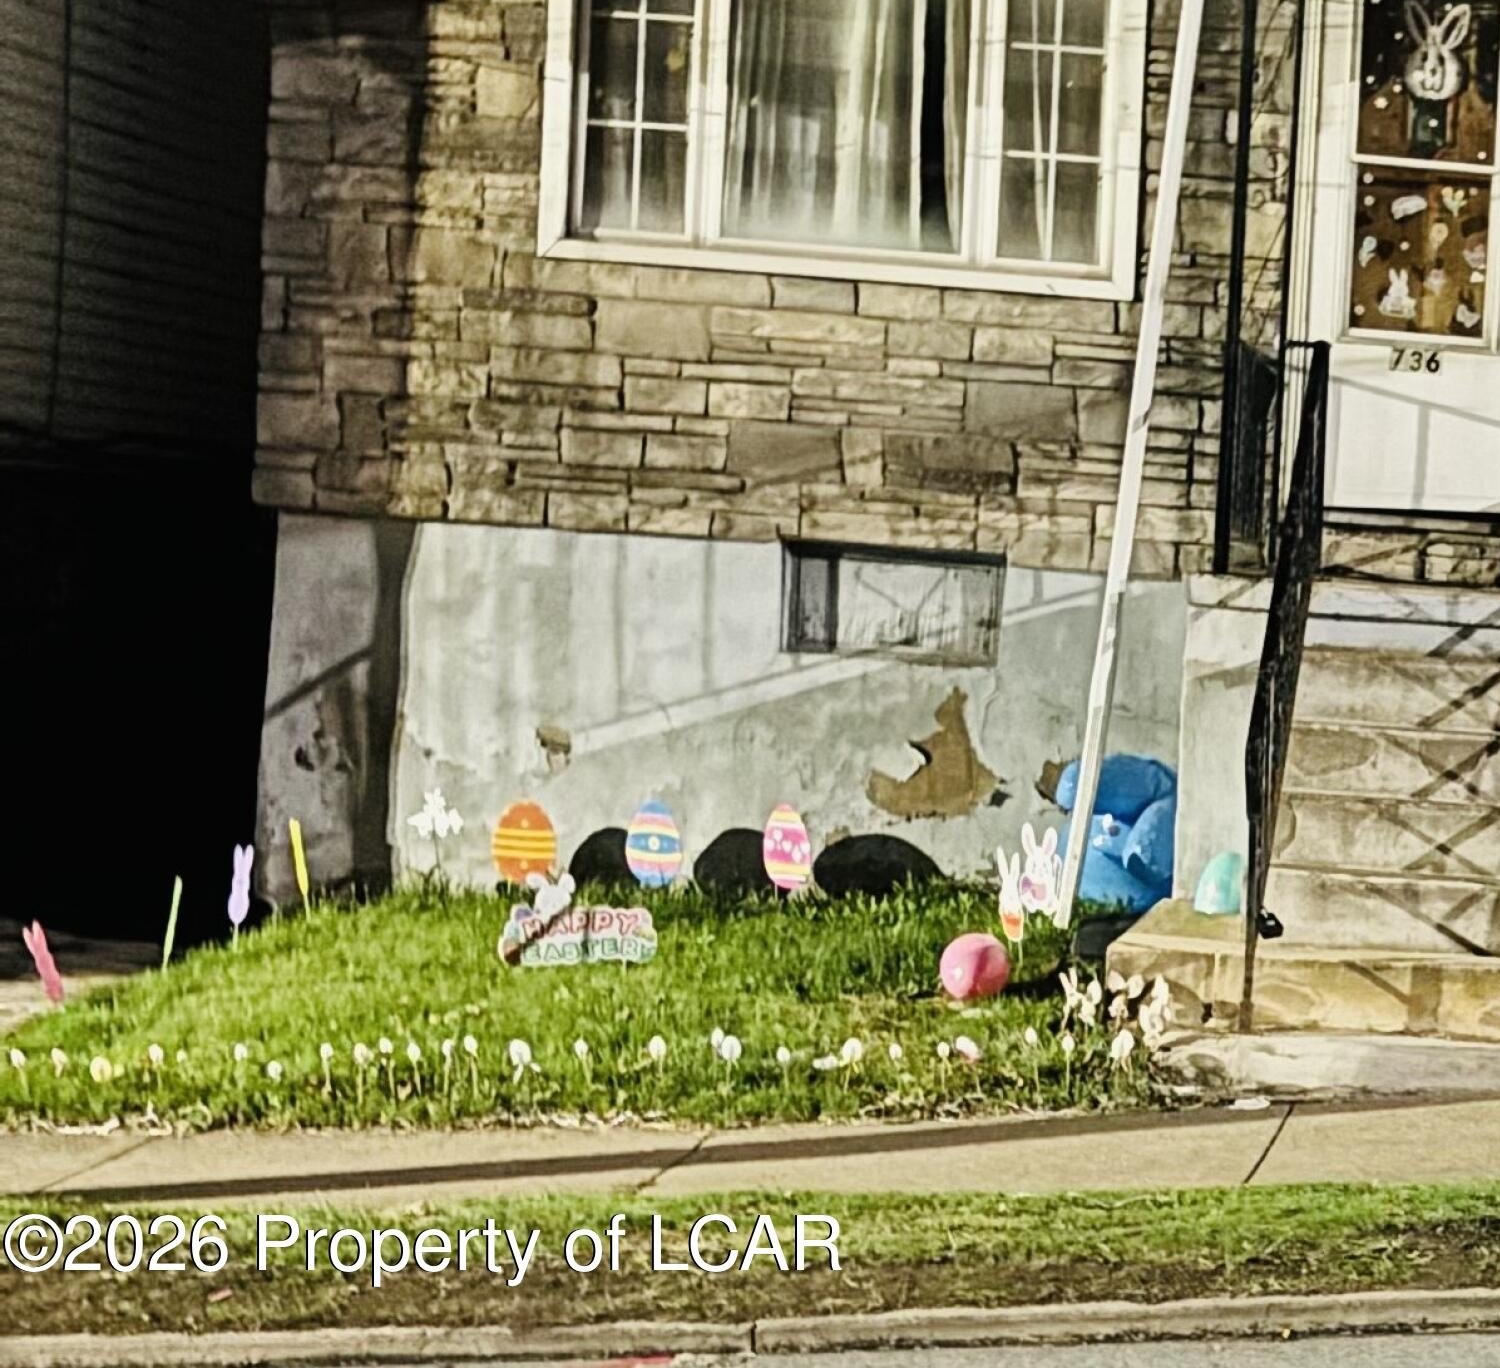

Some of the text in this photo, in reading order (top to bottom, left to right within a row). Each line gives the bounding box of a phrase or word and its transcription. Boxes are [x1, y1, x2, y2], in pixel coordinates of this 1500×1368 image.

[1388, 347, 1440, 373] 736
[521, 911, 638, 939] HAPPY
[522, 936, 639, 963] EASTER
